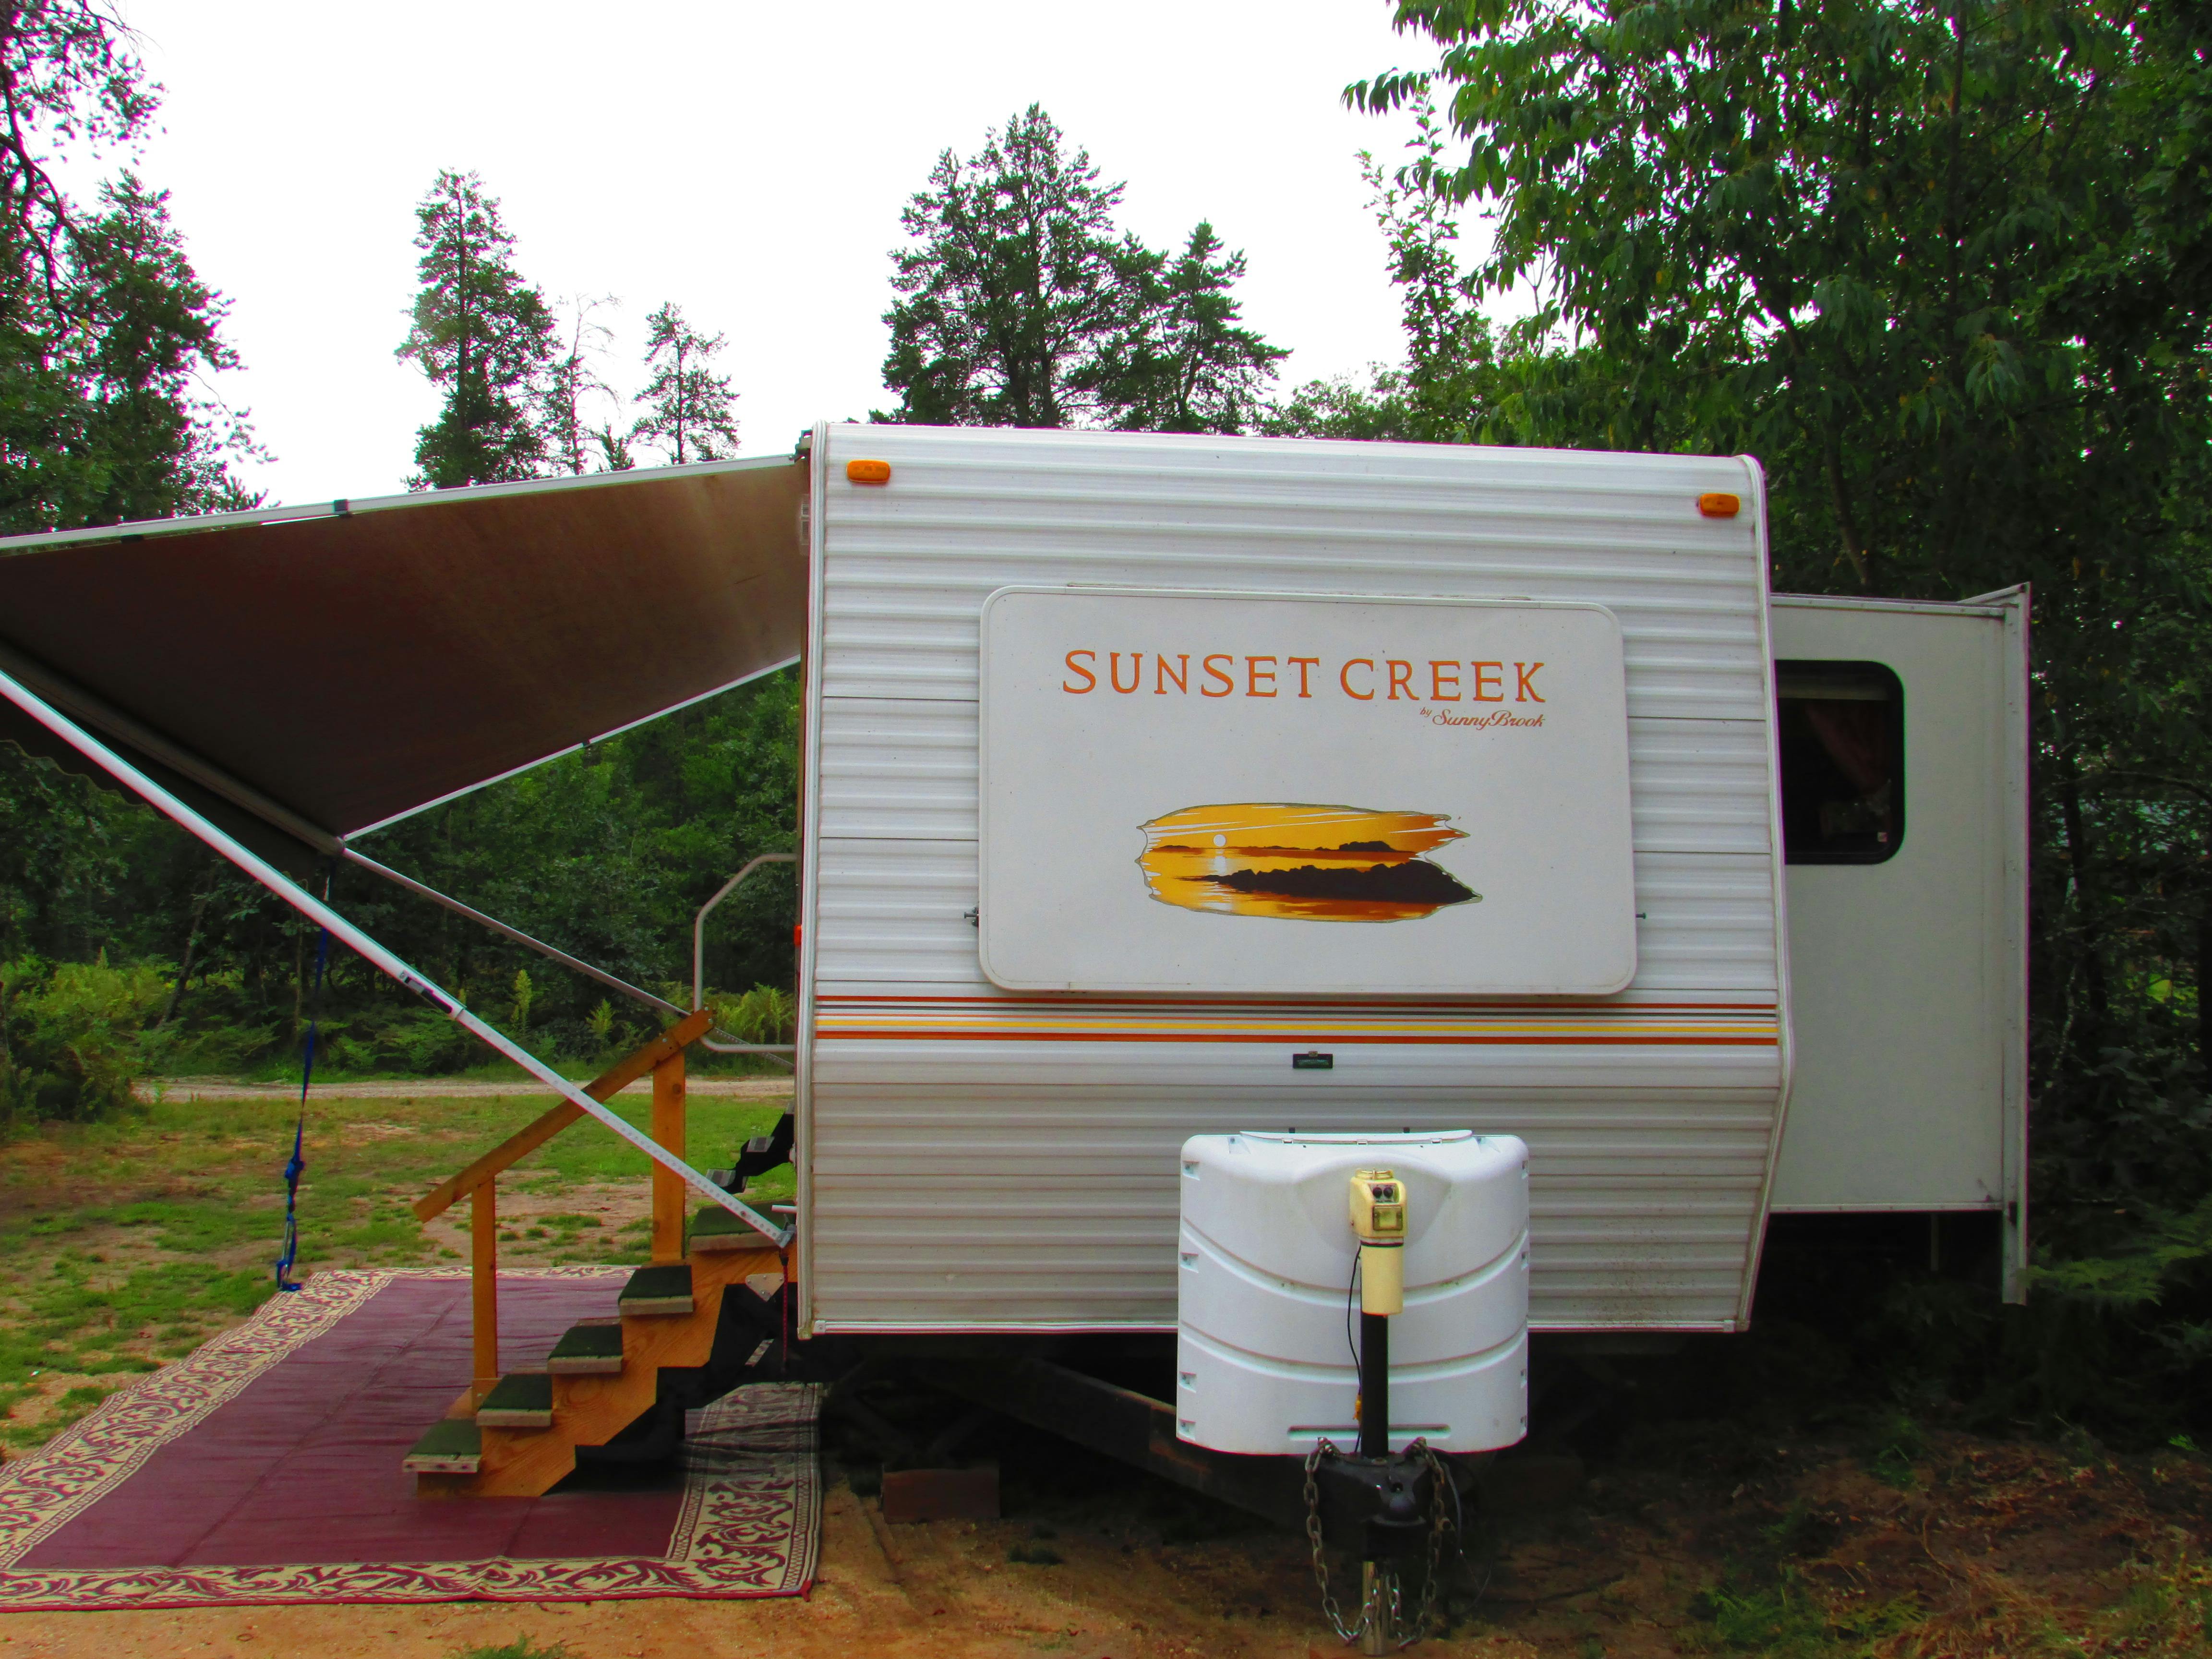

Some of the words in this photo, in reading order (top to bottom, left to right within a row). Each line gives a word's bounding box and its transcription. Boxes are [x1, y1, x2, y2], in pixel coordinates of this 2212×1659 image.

[1062, 649, 1321, 698] SUNSET
[1339, 658, 1547, 703] CREEK
[1419, 707, 1432, 718] by
[1432, 709, 1545, 731] SunnyBrook
